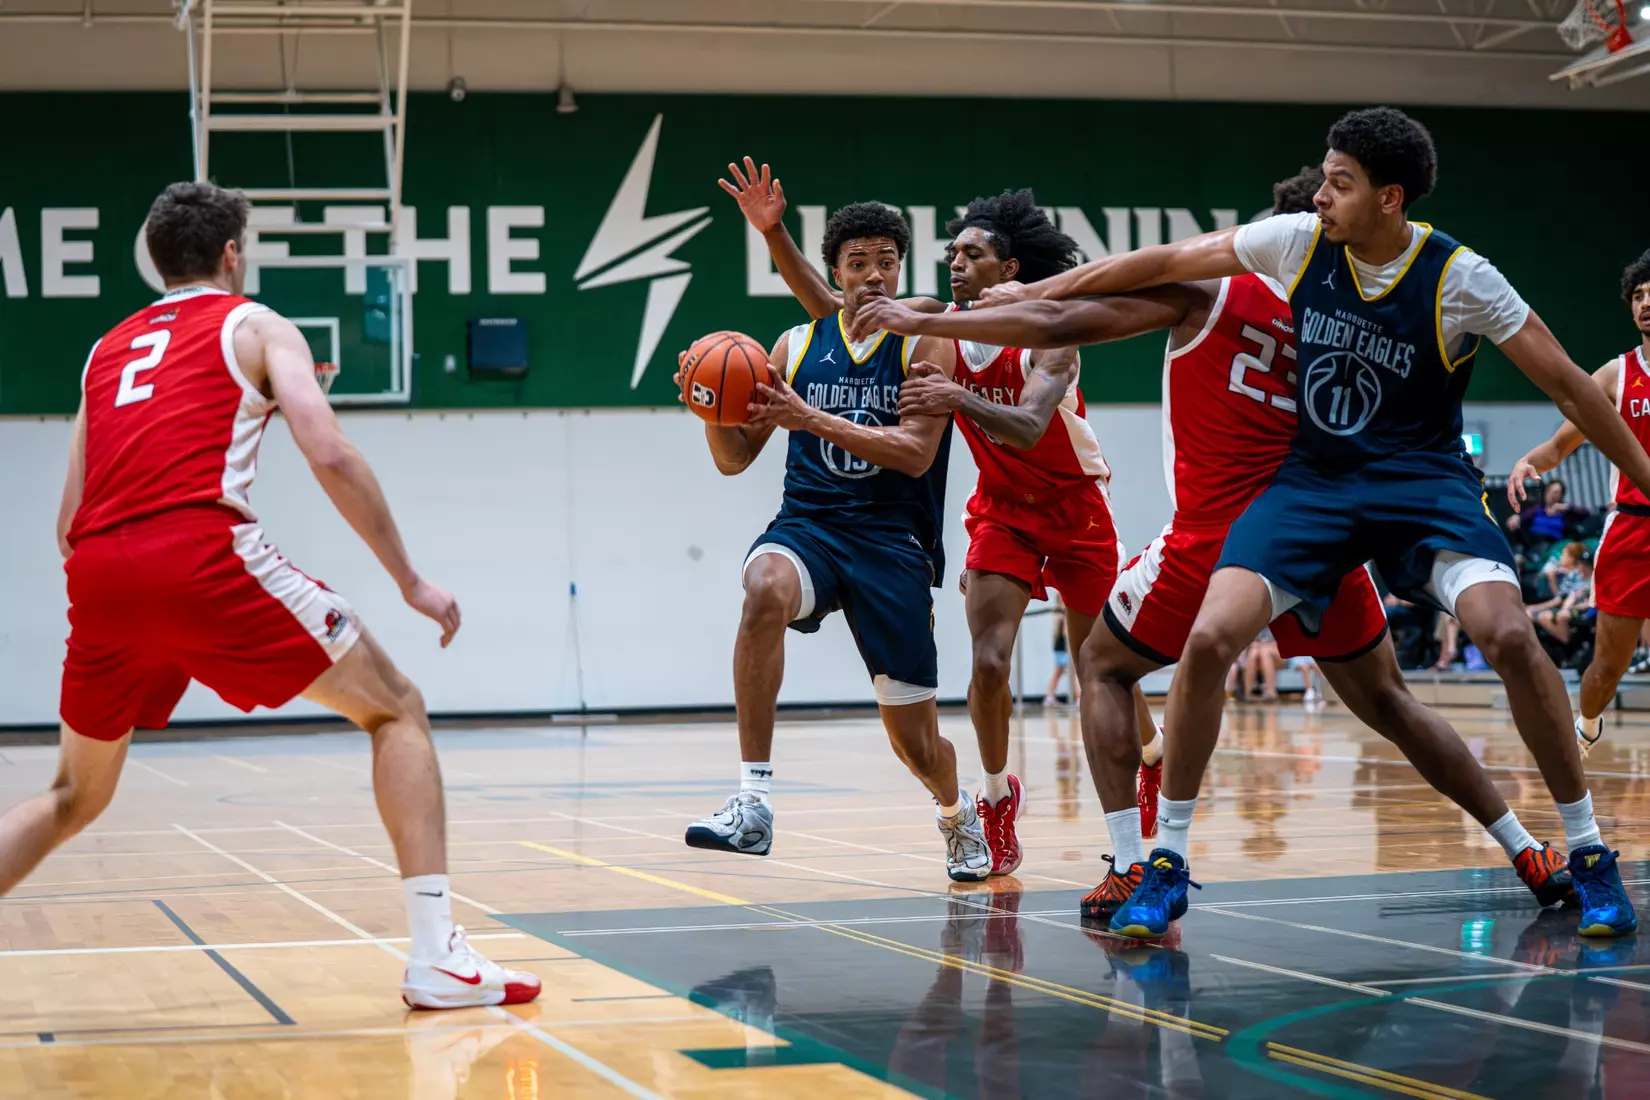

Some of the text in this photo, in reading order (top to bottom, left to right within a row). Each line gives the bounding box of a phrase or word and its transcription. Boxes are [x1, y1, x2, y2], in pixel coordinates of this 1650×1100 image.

[323, 205, 547, 295] THE
[1301, 306, 1416, 380] GOLDEN EAGLES
[1334, 308, 1384, 334] MARQUETTE
[114, 328, 172, 408] 2
[806, 382, 858, 410] GOLDEN
[1328, 385, 1352, 426] 11
